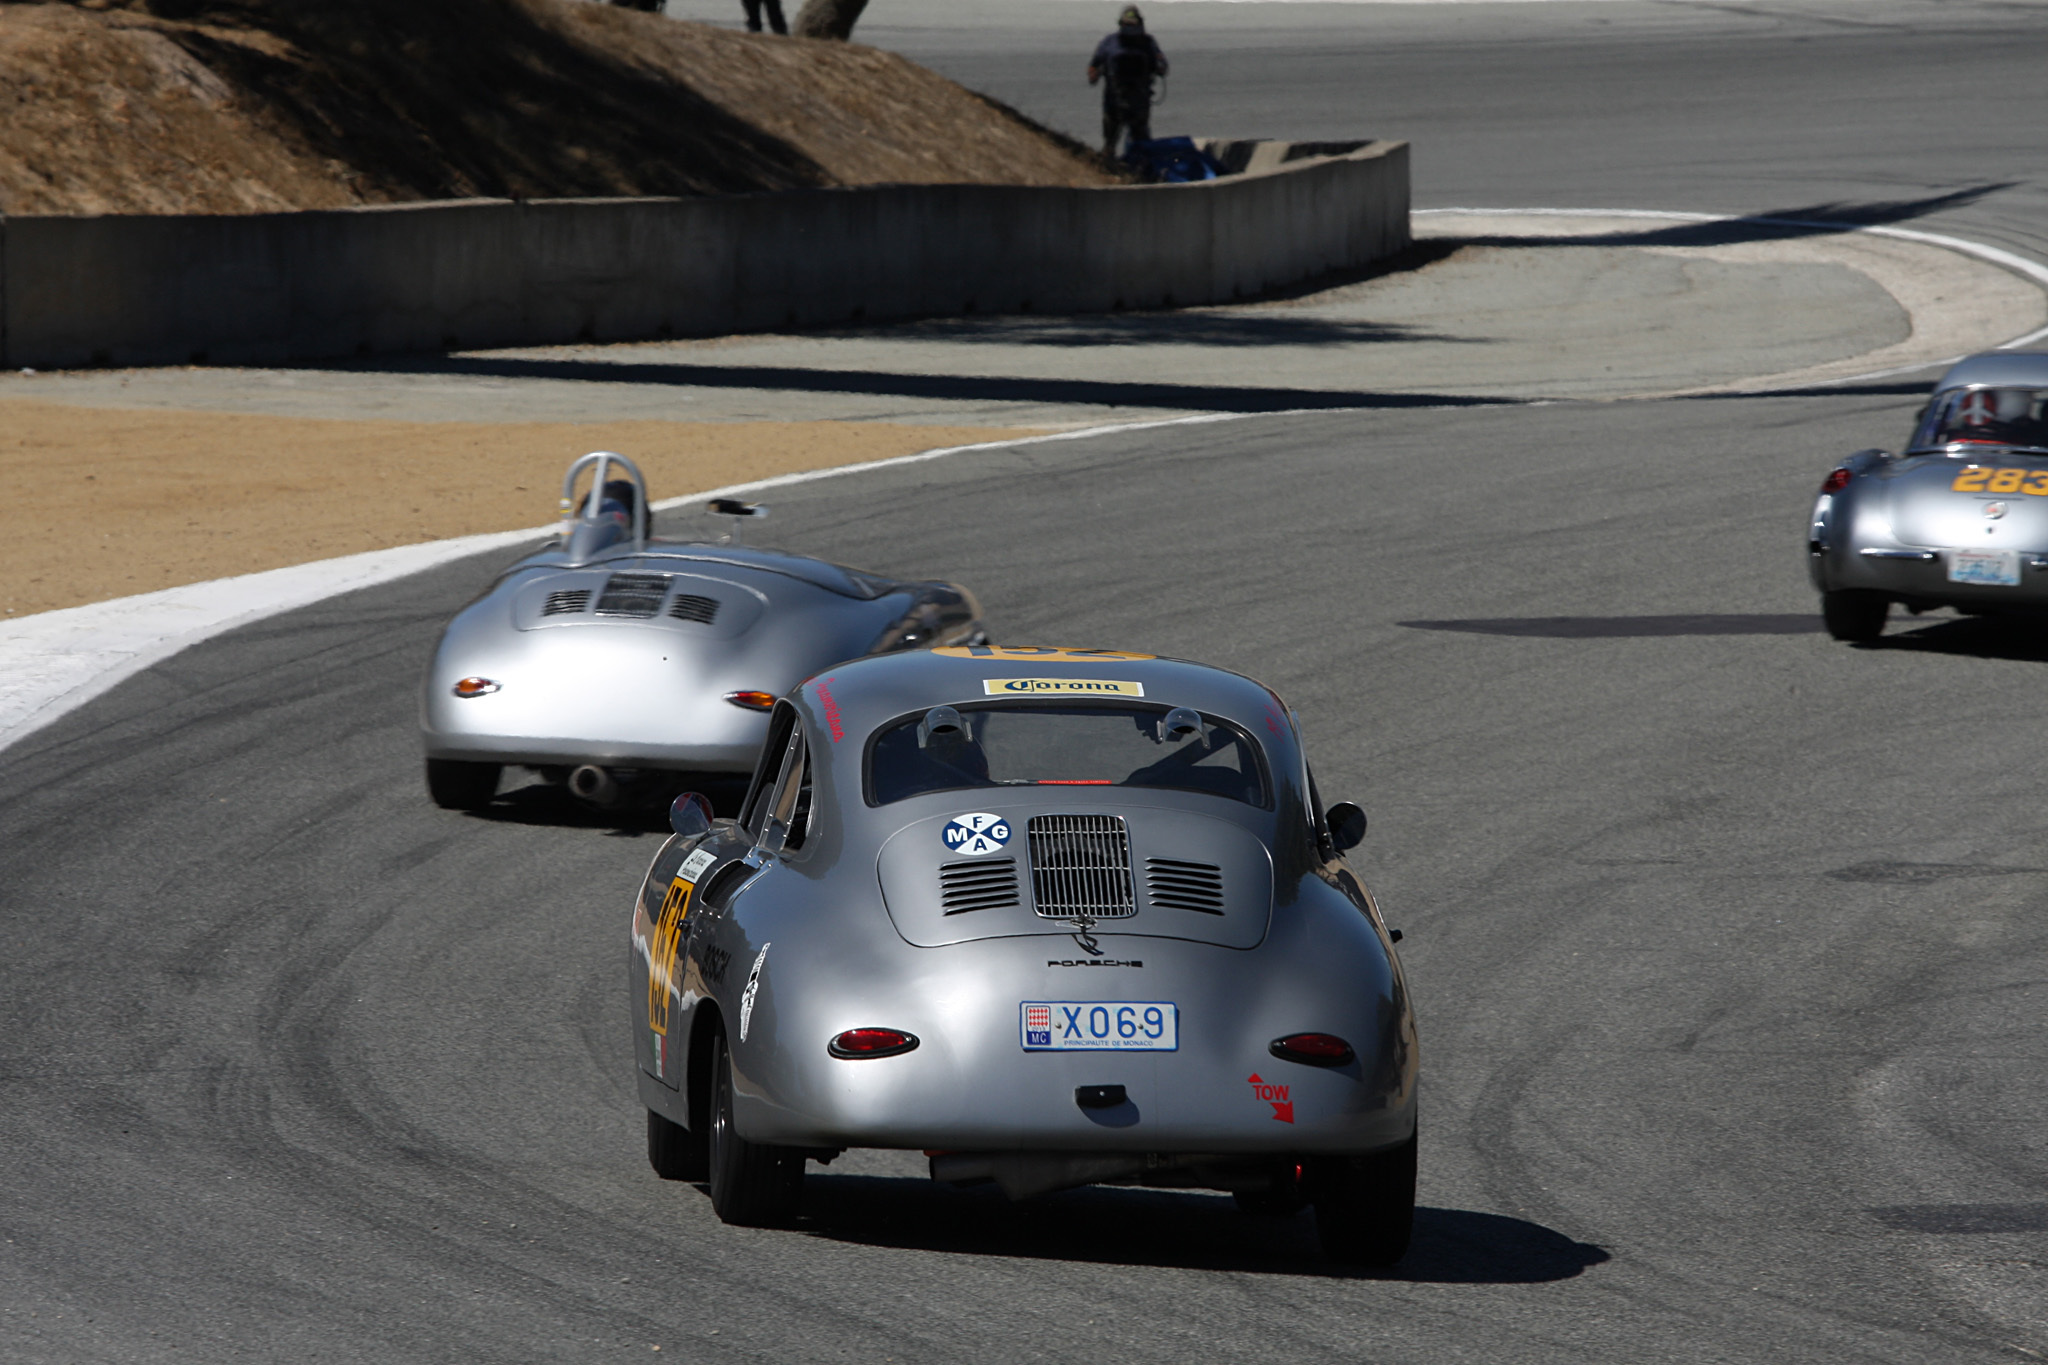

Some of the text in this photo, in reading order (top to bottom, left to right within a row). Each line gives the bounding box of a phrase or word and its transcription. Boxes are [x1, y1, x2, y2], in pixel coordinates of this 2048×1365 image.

[1951, 467, 2048, 496] 283
[1004, 679, 1120, 692] Corona
[1047, 960, 1144, 968] PORSCHE
[1031, 1033, 1047, 1044] MC
[1252, 1084, 1289, 1101] TOW
